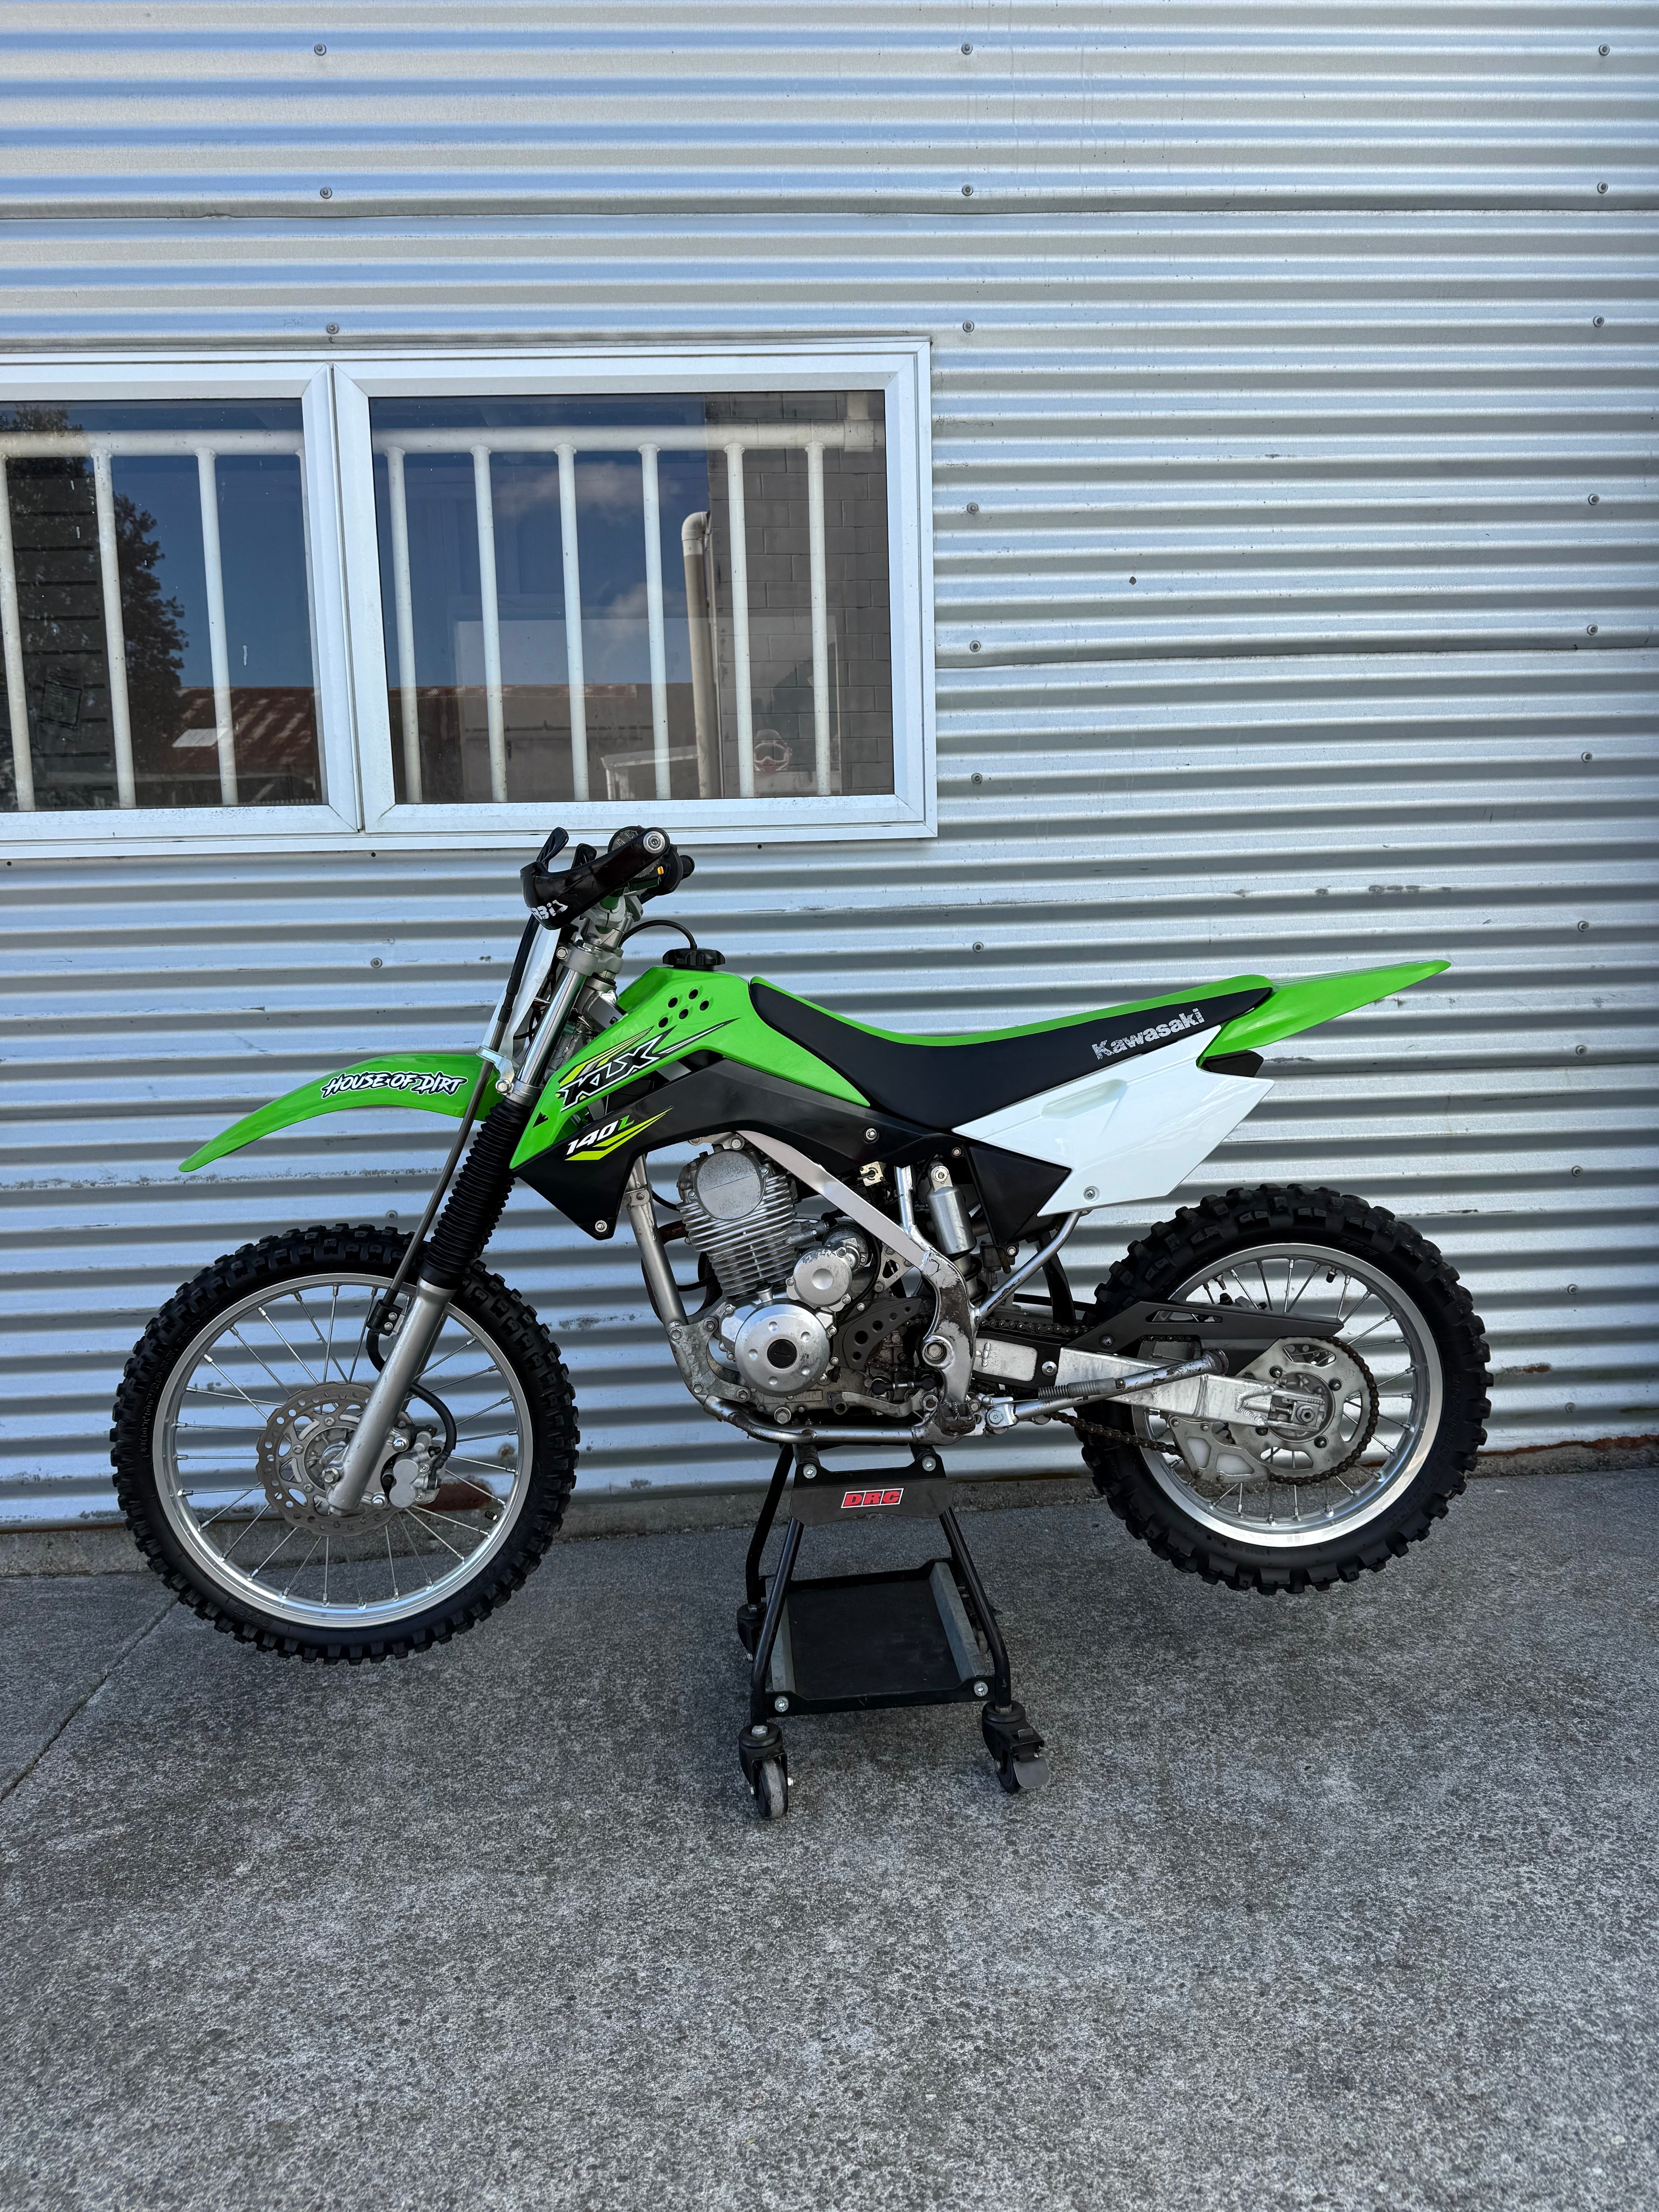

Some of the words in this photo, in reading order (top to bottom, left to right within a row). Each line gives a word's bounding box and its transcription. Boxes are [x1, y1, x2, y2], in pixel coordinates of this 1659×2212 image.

[1091, 1008, 1205, 1060] Kawasaki
[323, 1074, 388, 1096] HOUSE
[390, 1073, 416, 1089] OF
[414, 1072, 467, 1094] DIRT
[556, 1028, 668, 1112] KLX
[843, 1491, 900, 1506] DRC
